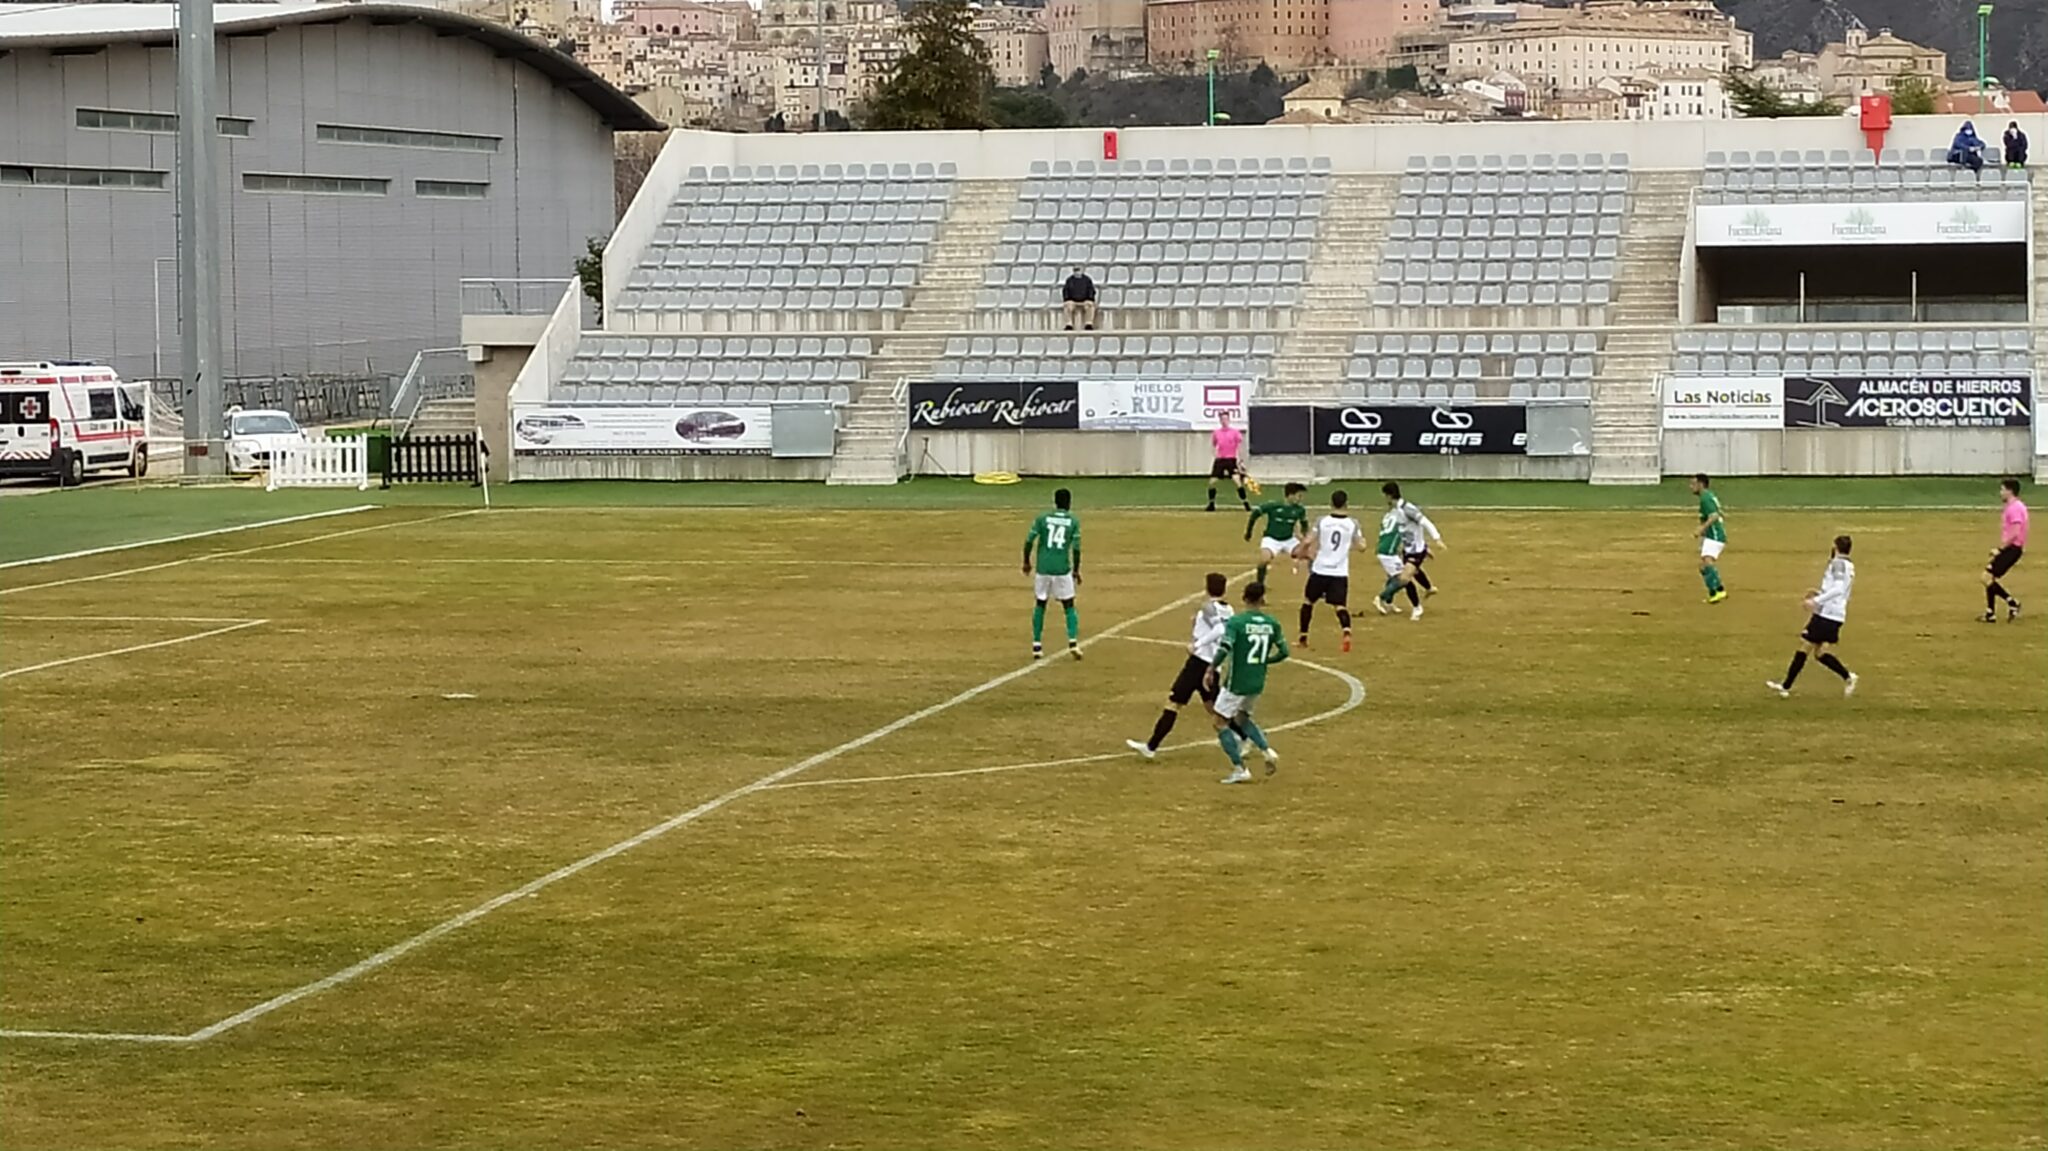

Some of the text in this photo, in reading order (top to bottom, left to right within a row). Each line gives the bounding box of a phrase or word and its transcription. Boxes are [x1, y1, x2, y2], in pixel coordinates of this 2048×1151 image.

[1134, 384, 1182, 393] HIELOS
[1858, 378, 2022, 393] ALMACÉN DE HIERROS
[1131, 396, 1184, 414] RUIZ
[1674, 389, 1772, 403] Las Noticias
[1845, 397, 2030, 417] ACEROSCUENCA
[1046, 523, 1067, 549] 14
[1331, 530, 1341, 552] 9
[1247, 634, 1269, 664] 21
